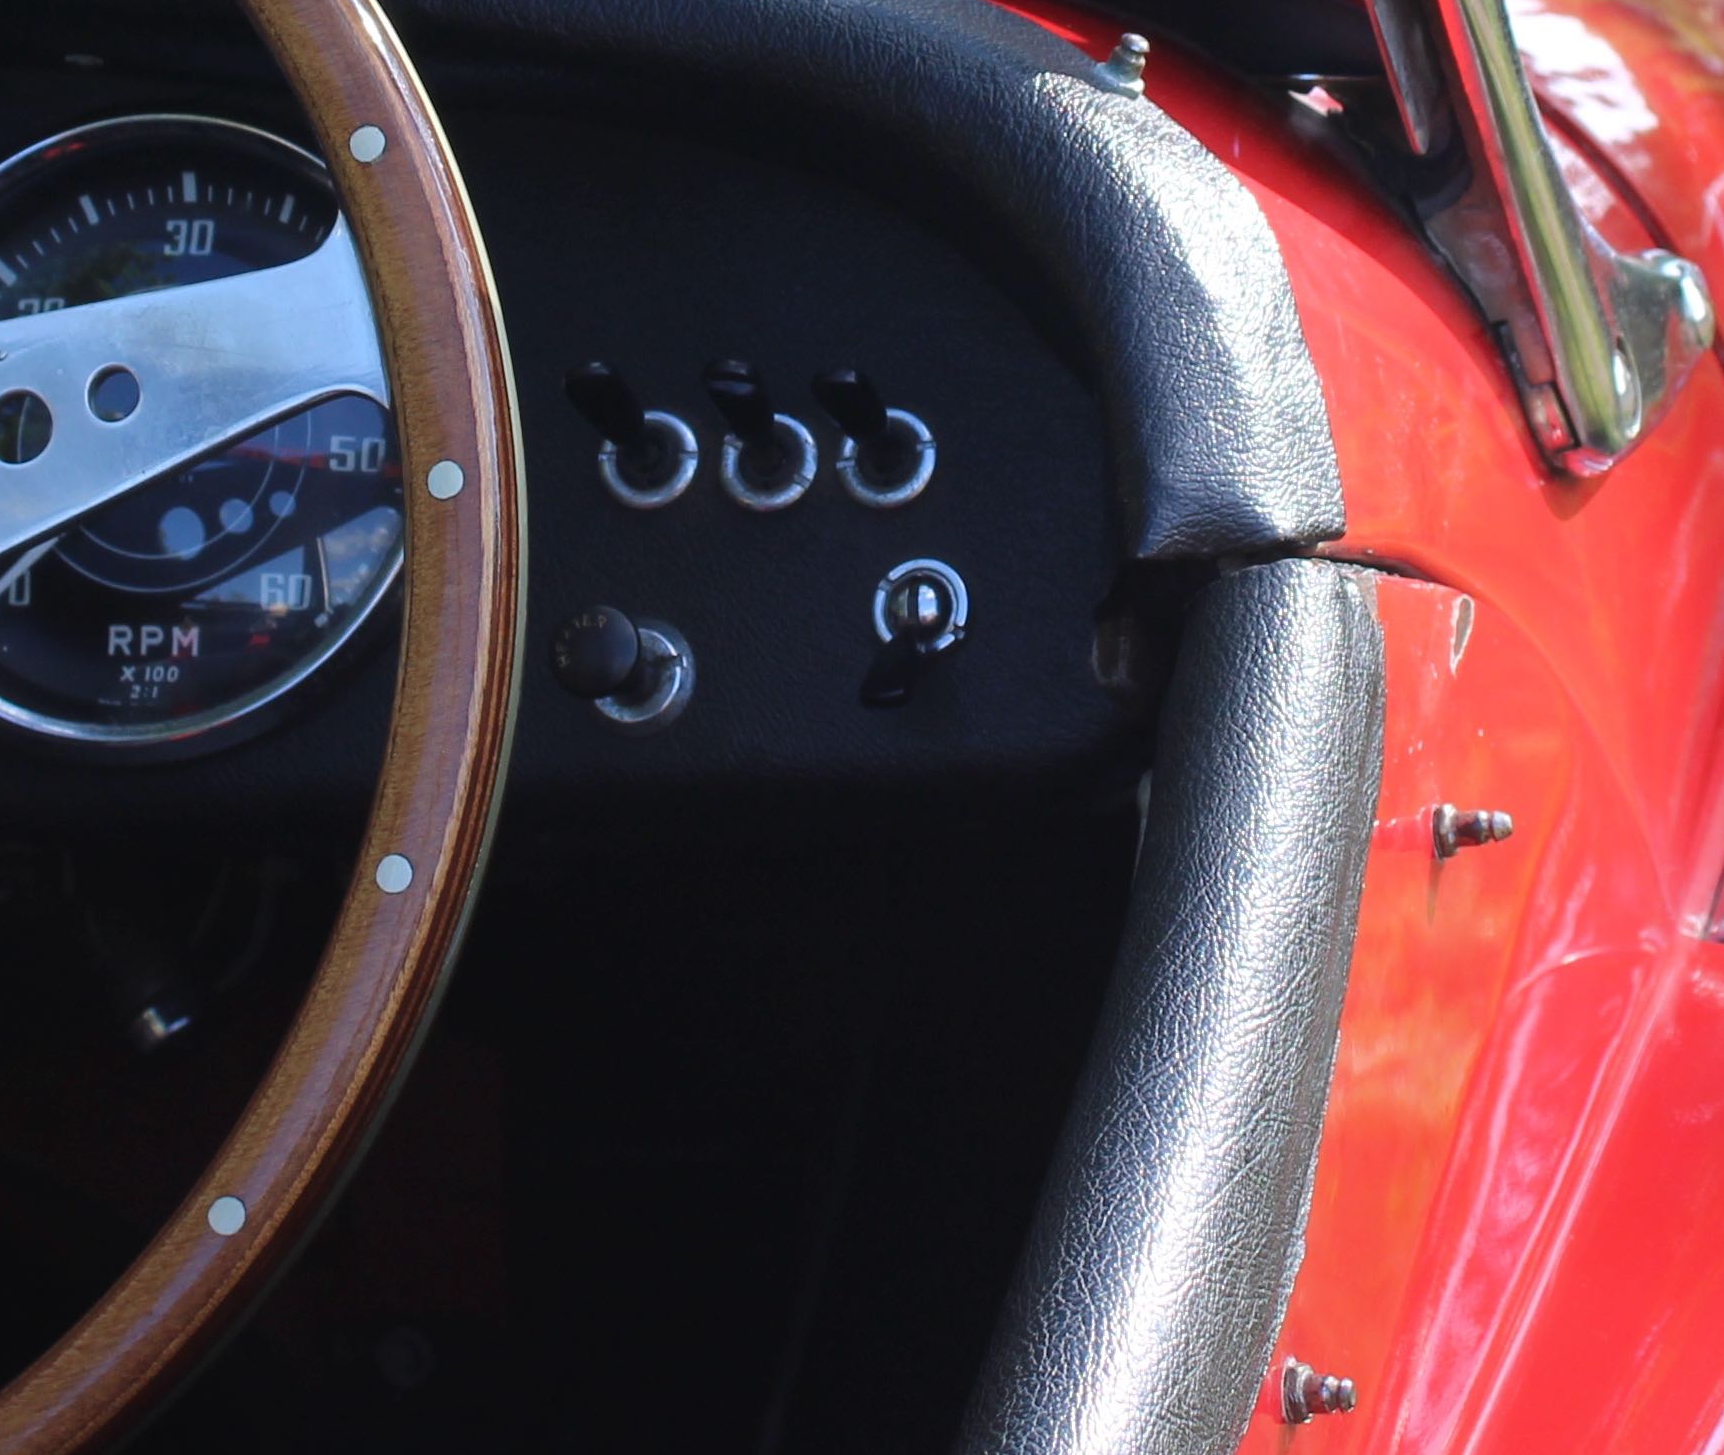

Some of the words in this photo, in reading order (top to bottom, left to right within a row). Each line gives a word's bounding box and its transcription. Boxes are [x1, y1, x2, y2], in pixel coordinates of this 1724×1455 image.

[162, 219, 215, 256] 30
[329, 435, 386, 473] 50
[259, 572, 313, 611] 60
[107, 624, 200, 657] RPM
[144, 665, 180, 683] 100
